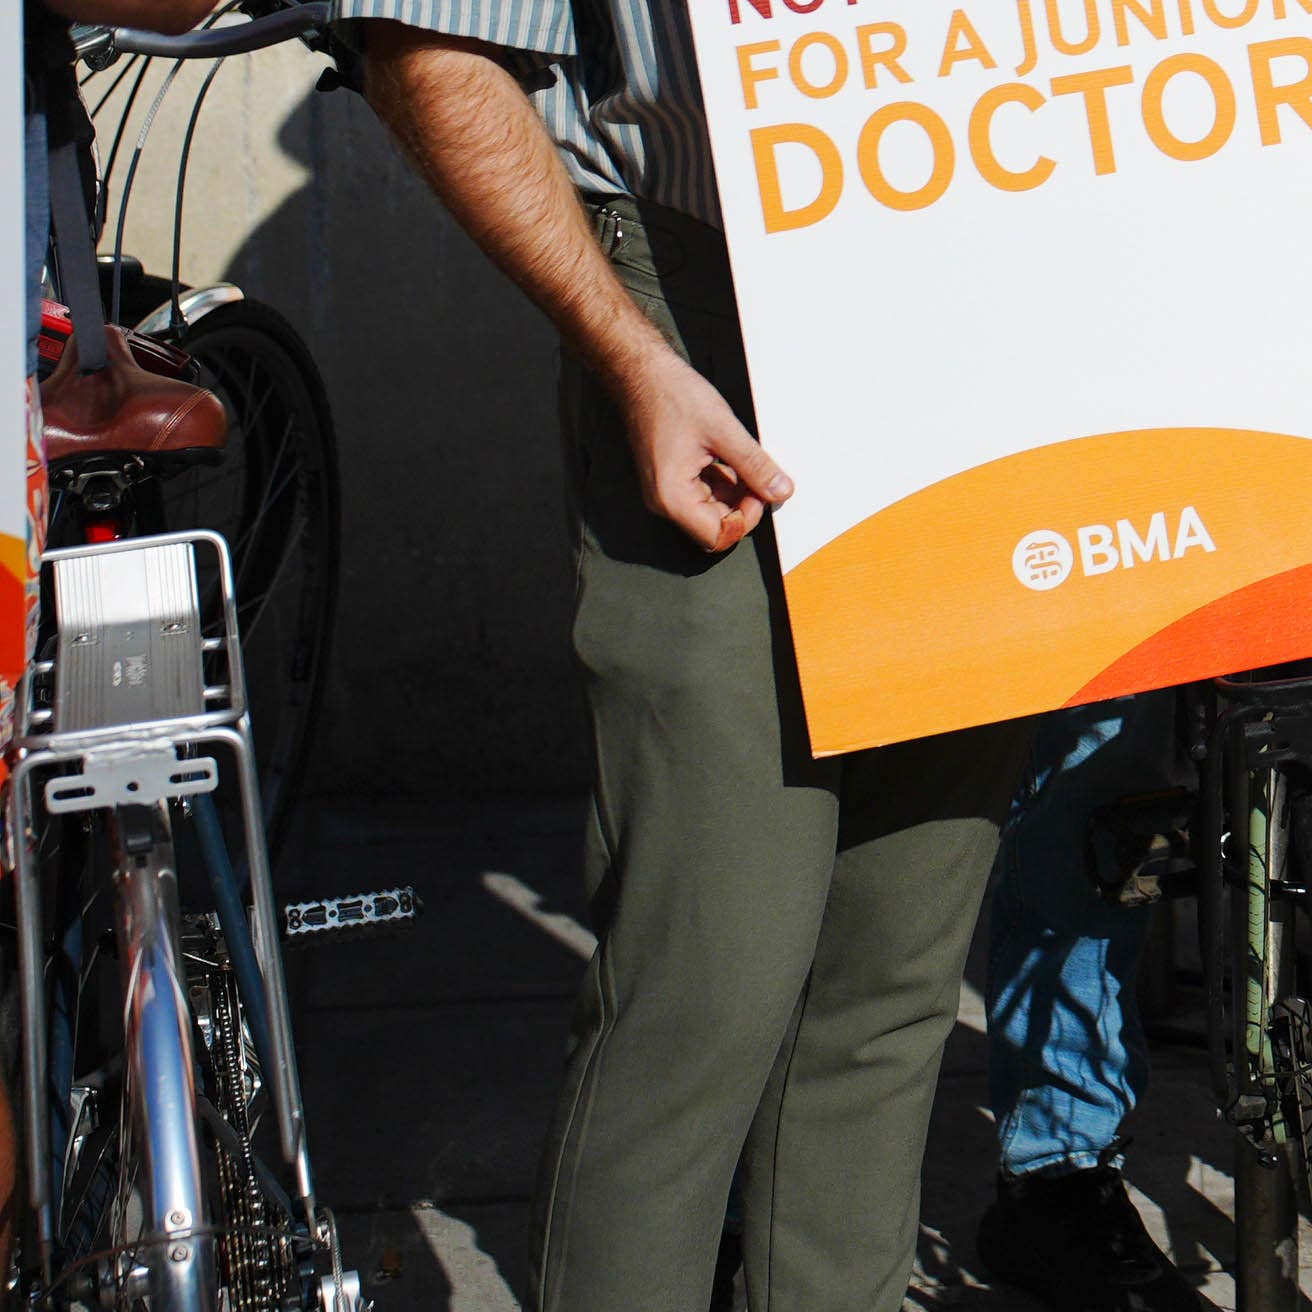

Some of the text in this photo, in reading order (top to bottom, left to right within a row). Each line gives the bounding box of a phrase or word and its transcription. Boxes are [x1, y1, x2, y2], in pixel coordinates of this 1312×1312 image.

[735, 21, 915, 110] FOR
[937, 9, 996, 77] A
[1077, 506, 1217, 576] BMA
